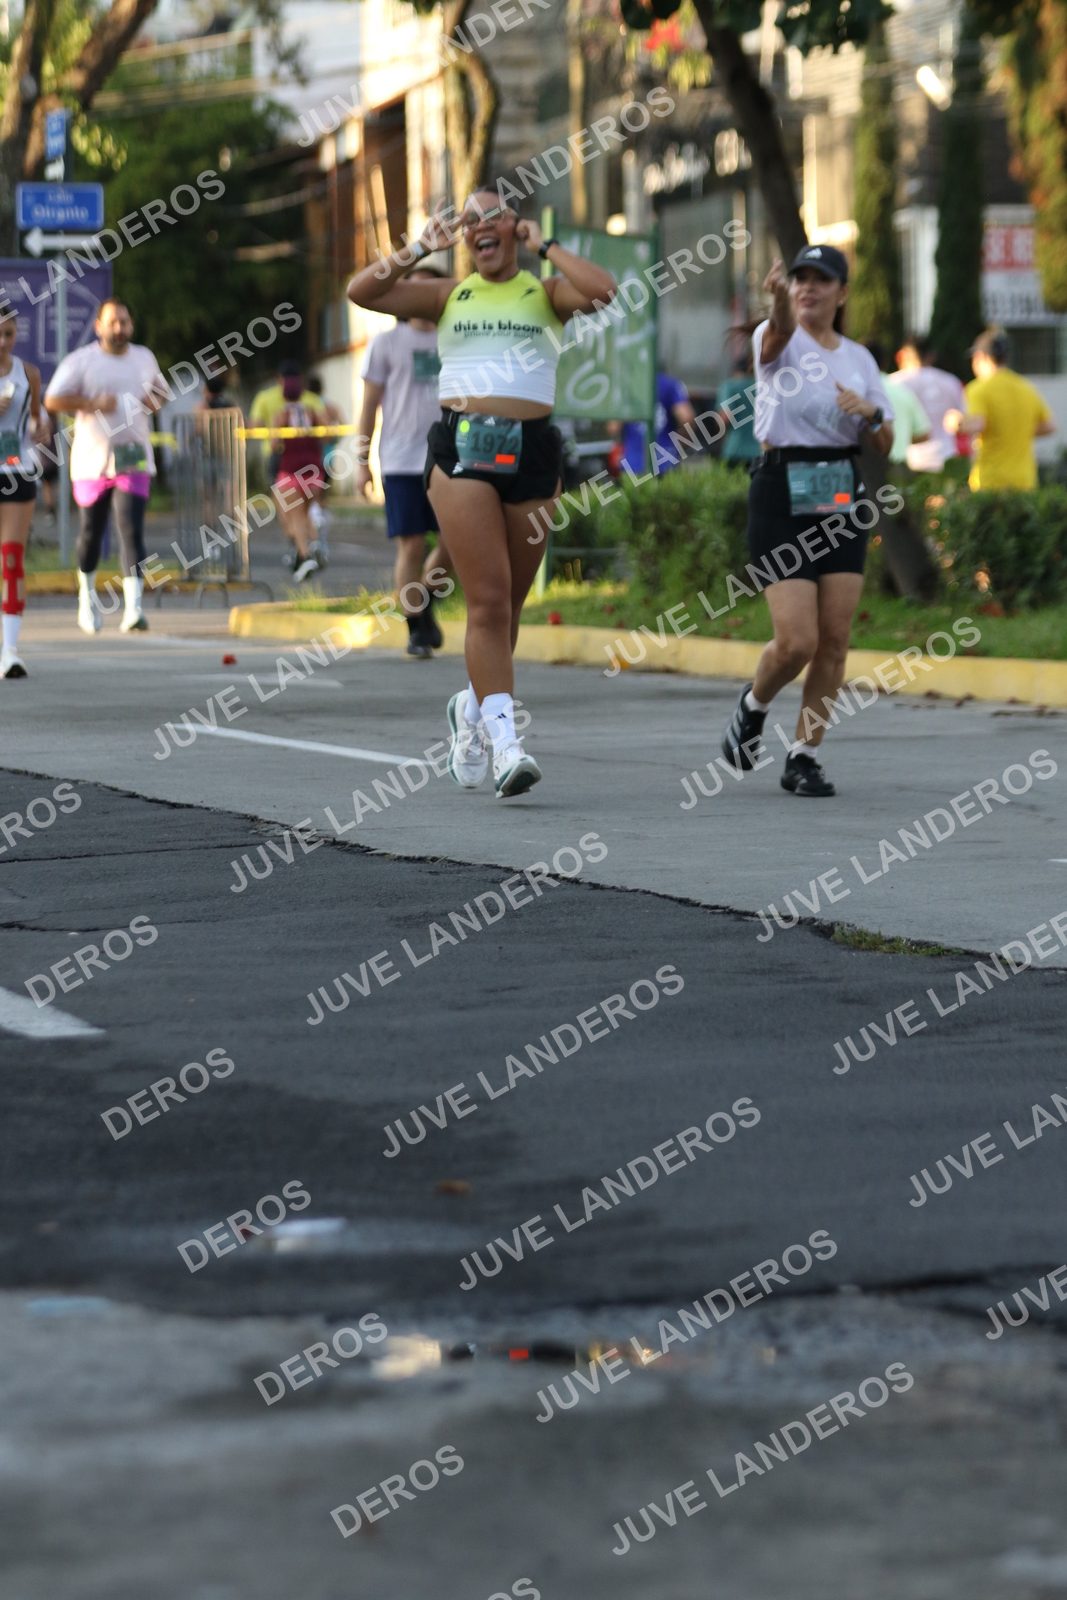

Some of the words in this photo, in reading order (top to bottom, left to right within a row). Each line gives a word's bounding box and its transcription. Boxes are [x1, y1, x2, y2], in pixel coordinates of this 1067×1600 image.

[454, 320, 478, 332] this
[483, 320, 494, 330] is
[498, 319, 543, 334] bloom
[471, 432, 520, 453] 1972
